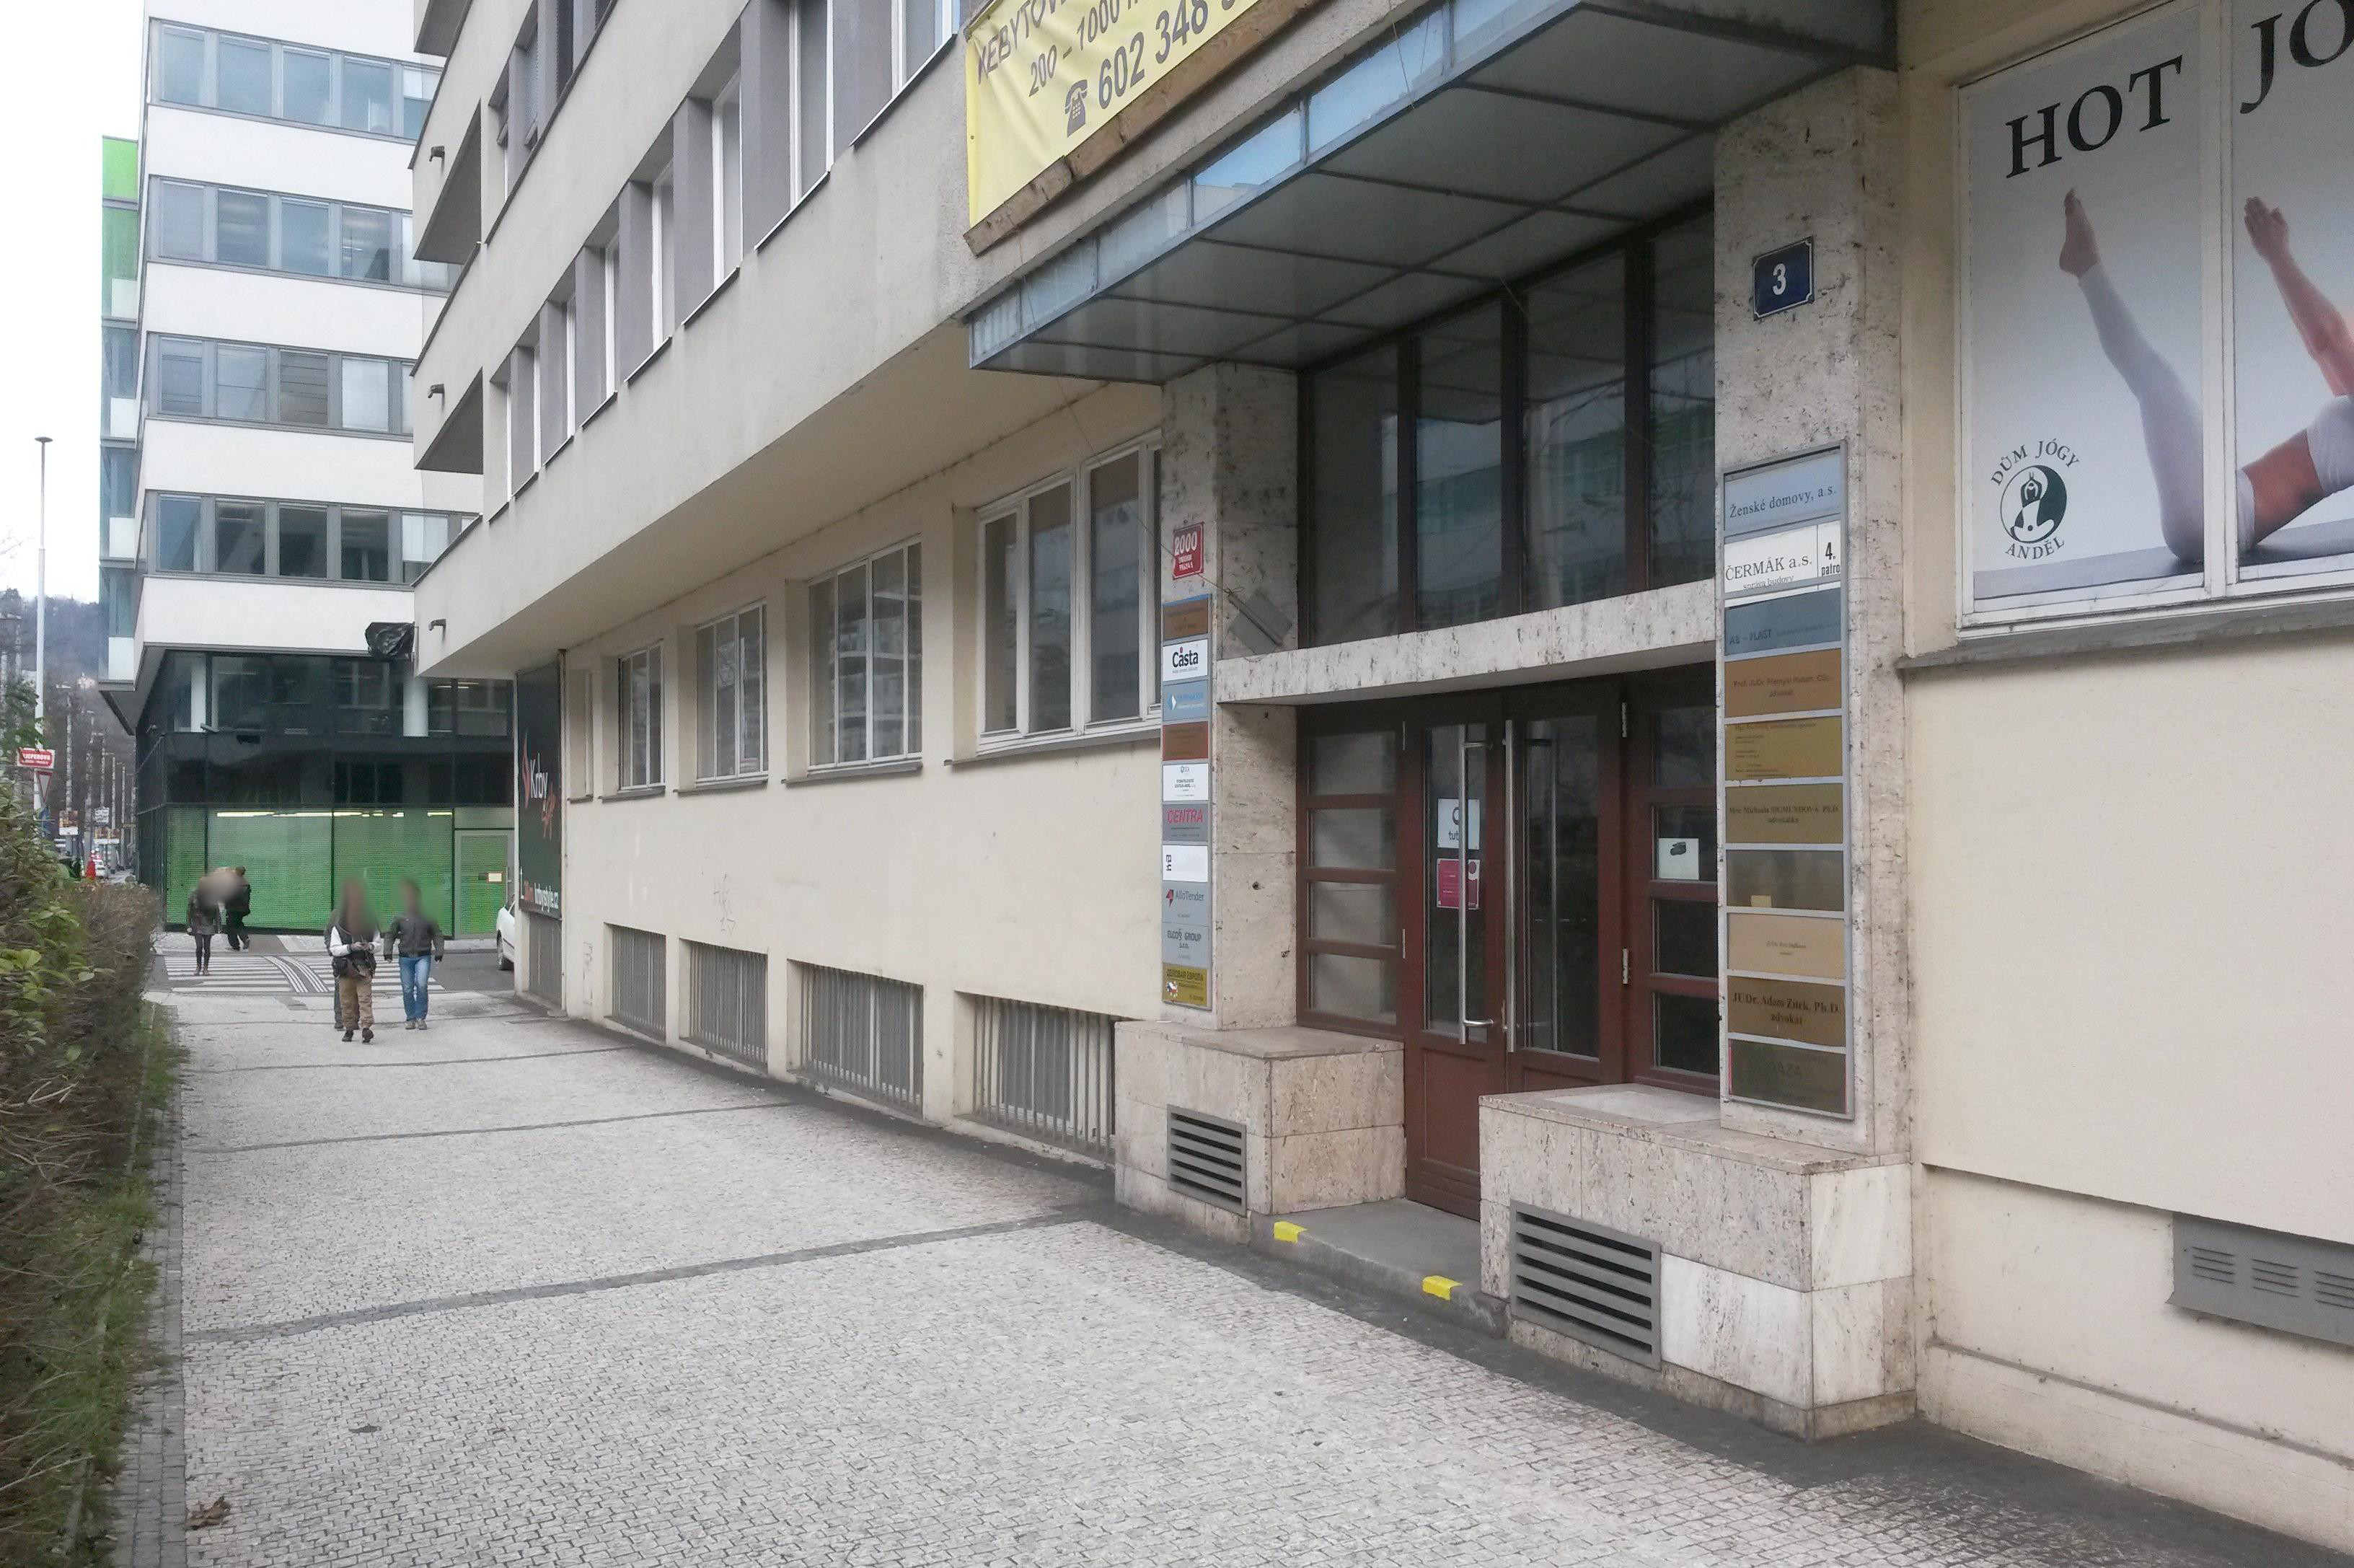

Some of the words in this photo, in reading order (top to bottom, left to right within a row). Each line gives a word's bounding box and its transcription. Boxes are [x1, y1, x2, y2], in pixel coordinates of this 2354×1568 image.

[1029, 45, 1057, 97] 200
[1077, 0, 1120, 51] 1000
[1098, 32, 1145, 110] 602
[1155, 0, 1209, 64] 348
[2006, 54, 2183, 180] HOT
[1773, 263, 1786, 296] 3
[1991, 444, 2028, 485] DŮM
[2035, 438, 2080, 468] JÓGY
[1729, 498, 1766, 519] Ženské
[1769, 490, 1814, 510] domovy,
[1174, 531, 1198, 556] 2000
[1825, 542, 1836, 561] 4.
[2005, 536, 2065, 560] ANDĚL
[1725, 556, 1785, 581] ČERMÁK
[1789, 555, 1812, 569] a.s.
[1767, 574, 1794, 586] budovy
[1821, 564, 1841, 578] patro
[1167, 809, 1204, 824] CENTRA
